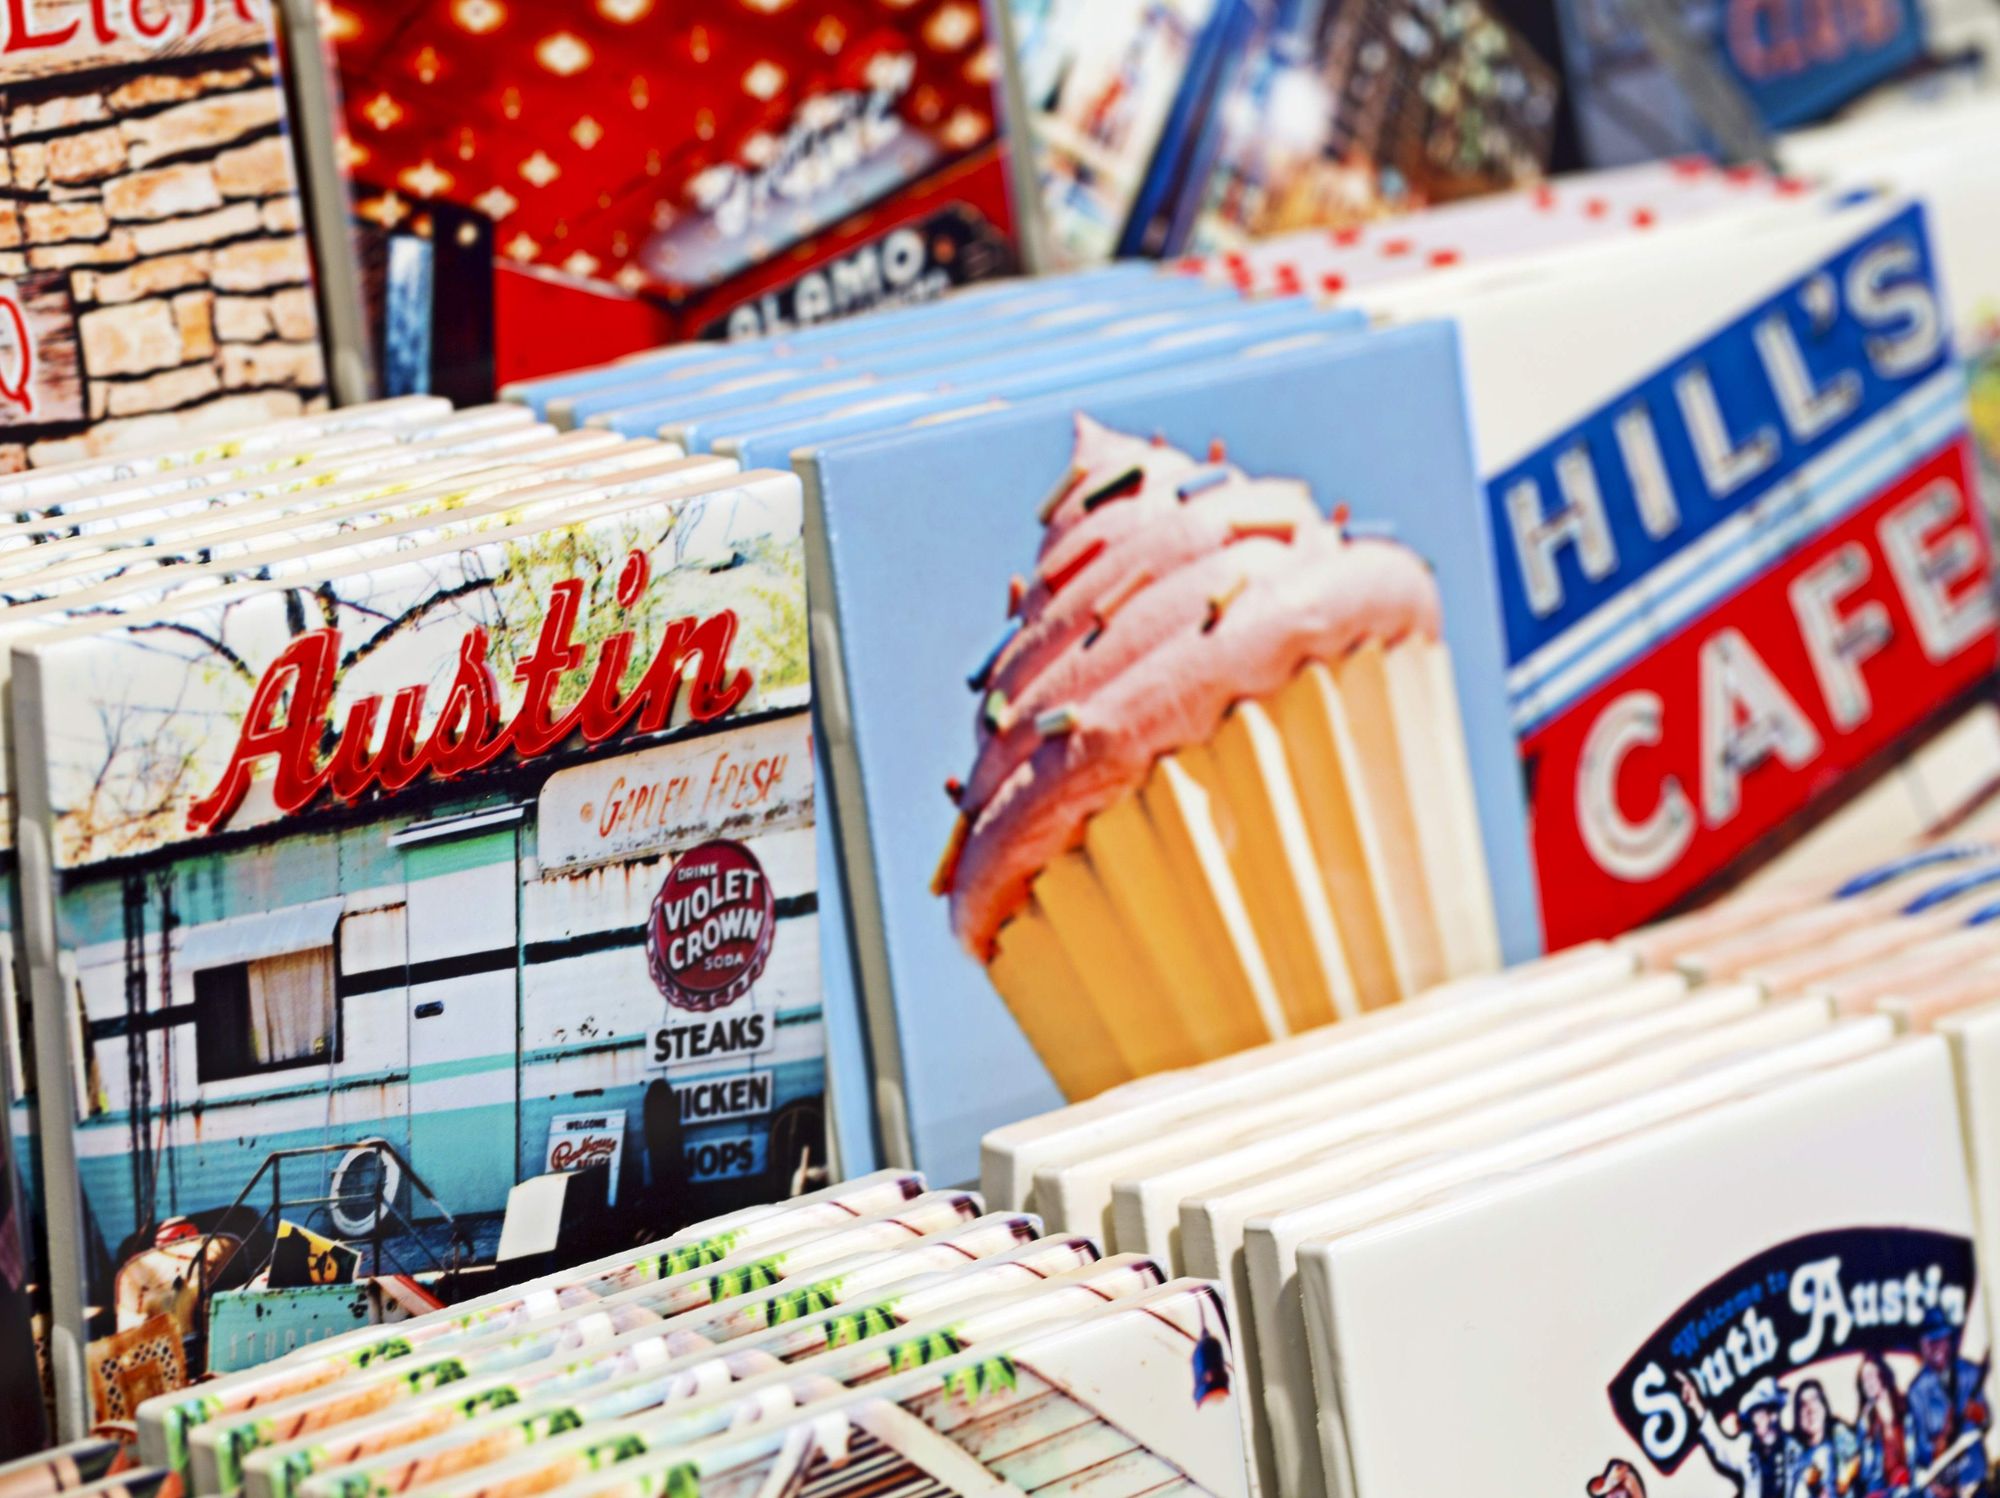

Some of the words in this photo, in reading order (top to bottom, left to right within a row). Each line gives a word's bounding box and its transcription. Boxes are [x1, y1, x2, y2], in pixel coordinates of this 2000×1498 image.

[727, 229, 925, 343] ALAMO
[1504, 238, 1940, 615] HILL'S
[186, 578, 751, 832] Austin
[1575, 475, 2000, 882] CAFE
[664, 869, 759, 932] VIOLET
[677, 862, 718, 881] DRINK
[669, 908, 764, 970] CROWN
[704, 953, 744, 971] SODA
[654, 1014, 764, 1062] STEAKS
[673, 1077, 767, 1119] ICKEN
[687, 1139, 753, 1177] OPS
[1671, 1282, 1762, 1357] Welcome
[1789, 1256, 1966, 1364] Austin
